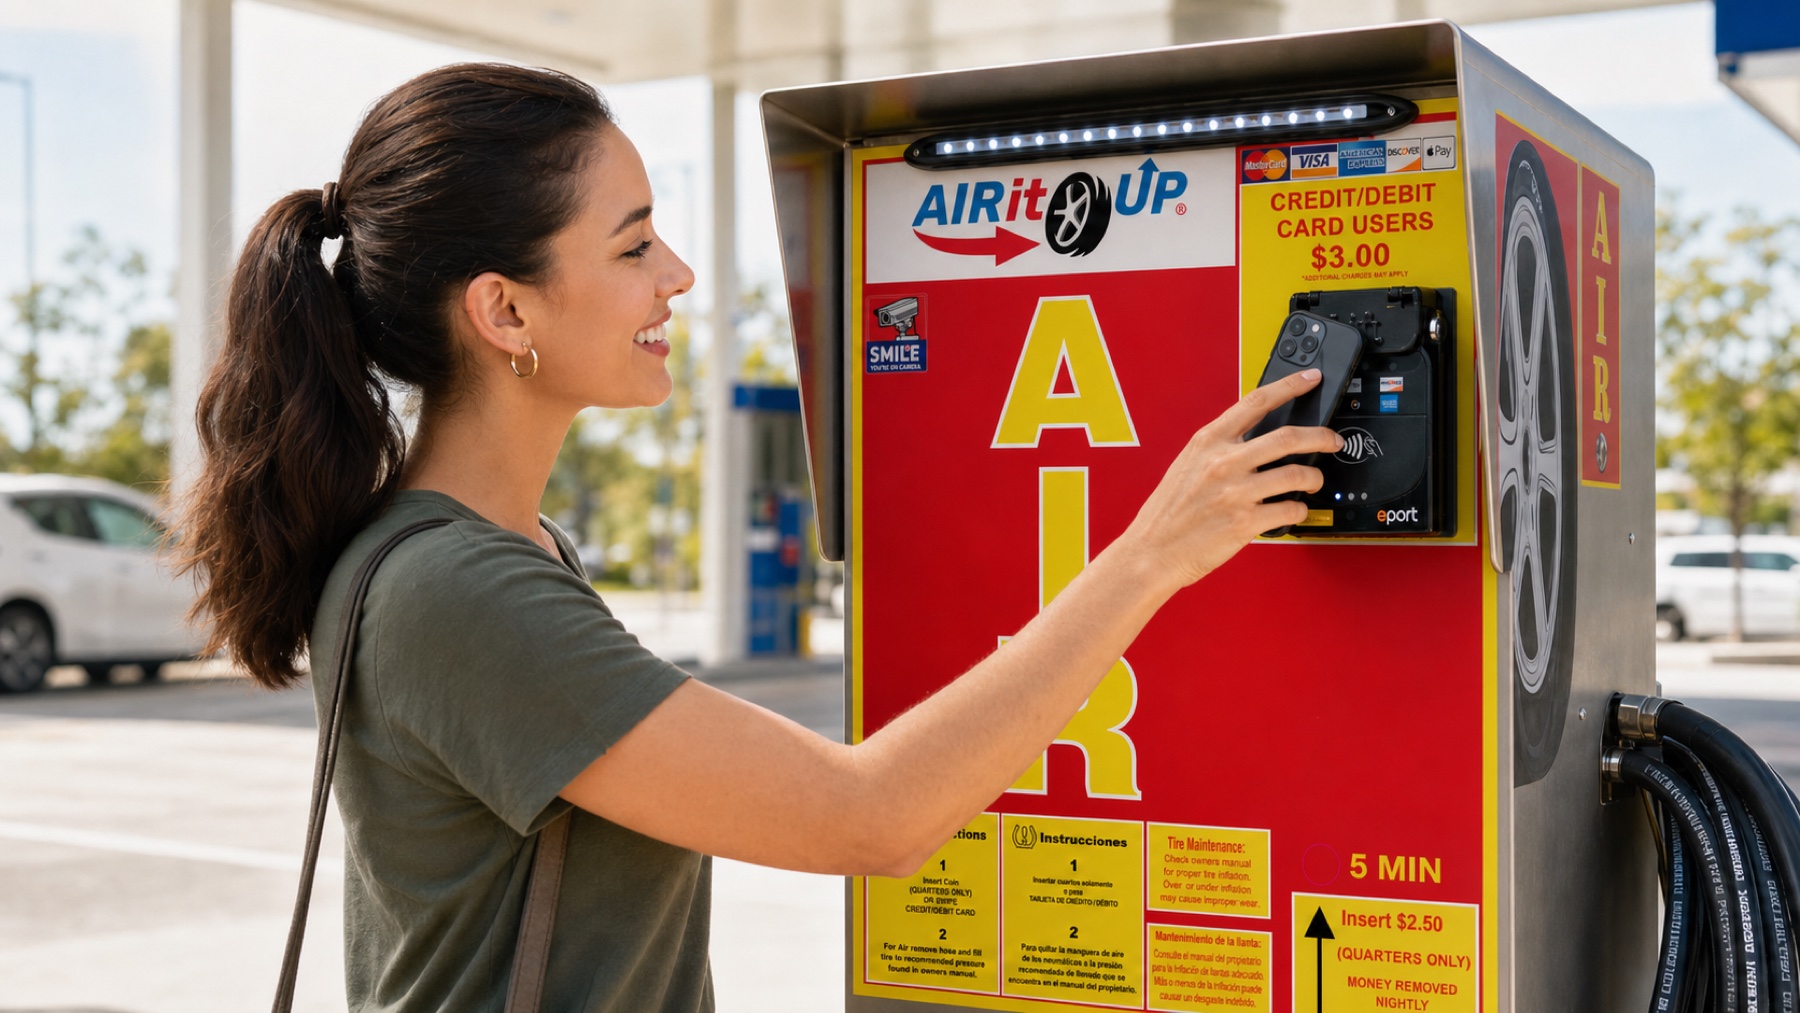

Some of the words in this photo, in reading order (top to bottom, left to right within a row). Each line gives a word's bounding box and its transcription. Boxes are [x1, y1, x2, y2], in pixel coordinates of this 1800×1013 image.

[1388, 147, 1419, 156] DISCOVER
[1435, 145, 1451, 158] Pay
[1299, 154, 1329, 168] VISA
[1270, 183, 1436, 211] CREDIT/DEBIT
[1277, 217, 1344, 238] CARD
[1352, 211, 1434, 235] USERS
[1311, 243, 1390, 271] $3.00
[1591, 191, 1612, 425] AIR
[870, 345, 919, 363] SMILE
[1377, 507, 1418, 525] eport
[1040, 833, 1127, 847] Instrucciones
[1168, 836, 1184, 850] Tire
[1187, 837, 1246, 853] Maintenance:
[940, 859, 946, 871] 1
[1070, 859, 1077, 871] 1
[1164, 867, 1174, 876] for
[1350, 853, 1367, 879] 5
[1379, 855, 1441, 883] MIN
[1342, 910, 1391, 929] Insert
[1397, 913, 1443, 932] $2.50
[939, 929, 946, 940] 2
[1069, 926, 1078, 938] 2
[1337, 947, 1422, 965] (QUARTERS
[1427, 953, 1471, 971] ONLY)
[888, 964, 910, 973] found
[1348, 976, 1391, 990] MONEY
[1395, 980, 1458, 995] REMOVED
[1376, 996, 1429, 1011] NIGHTLY
